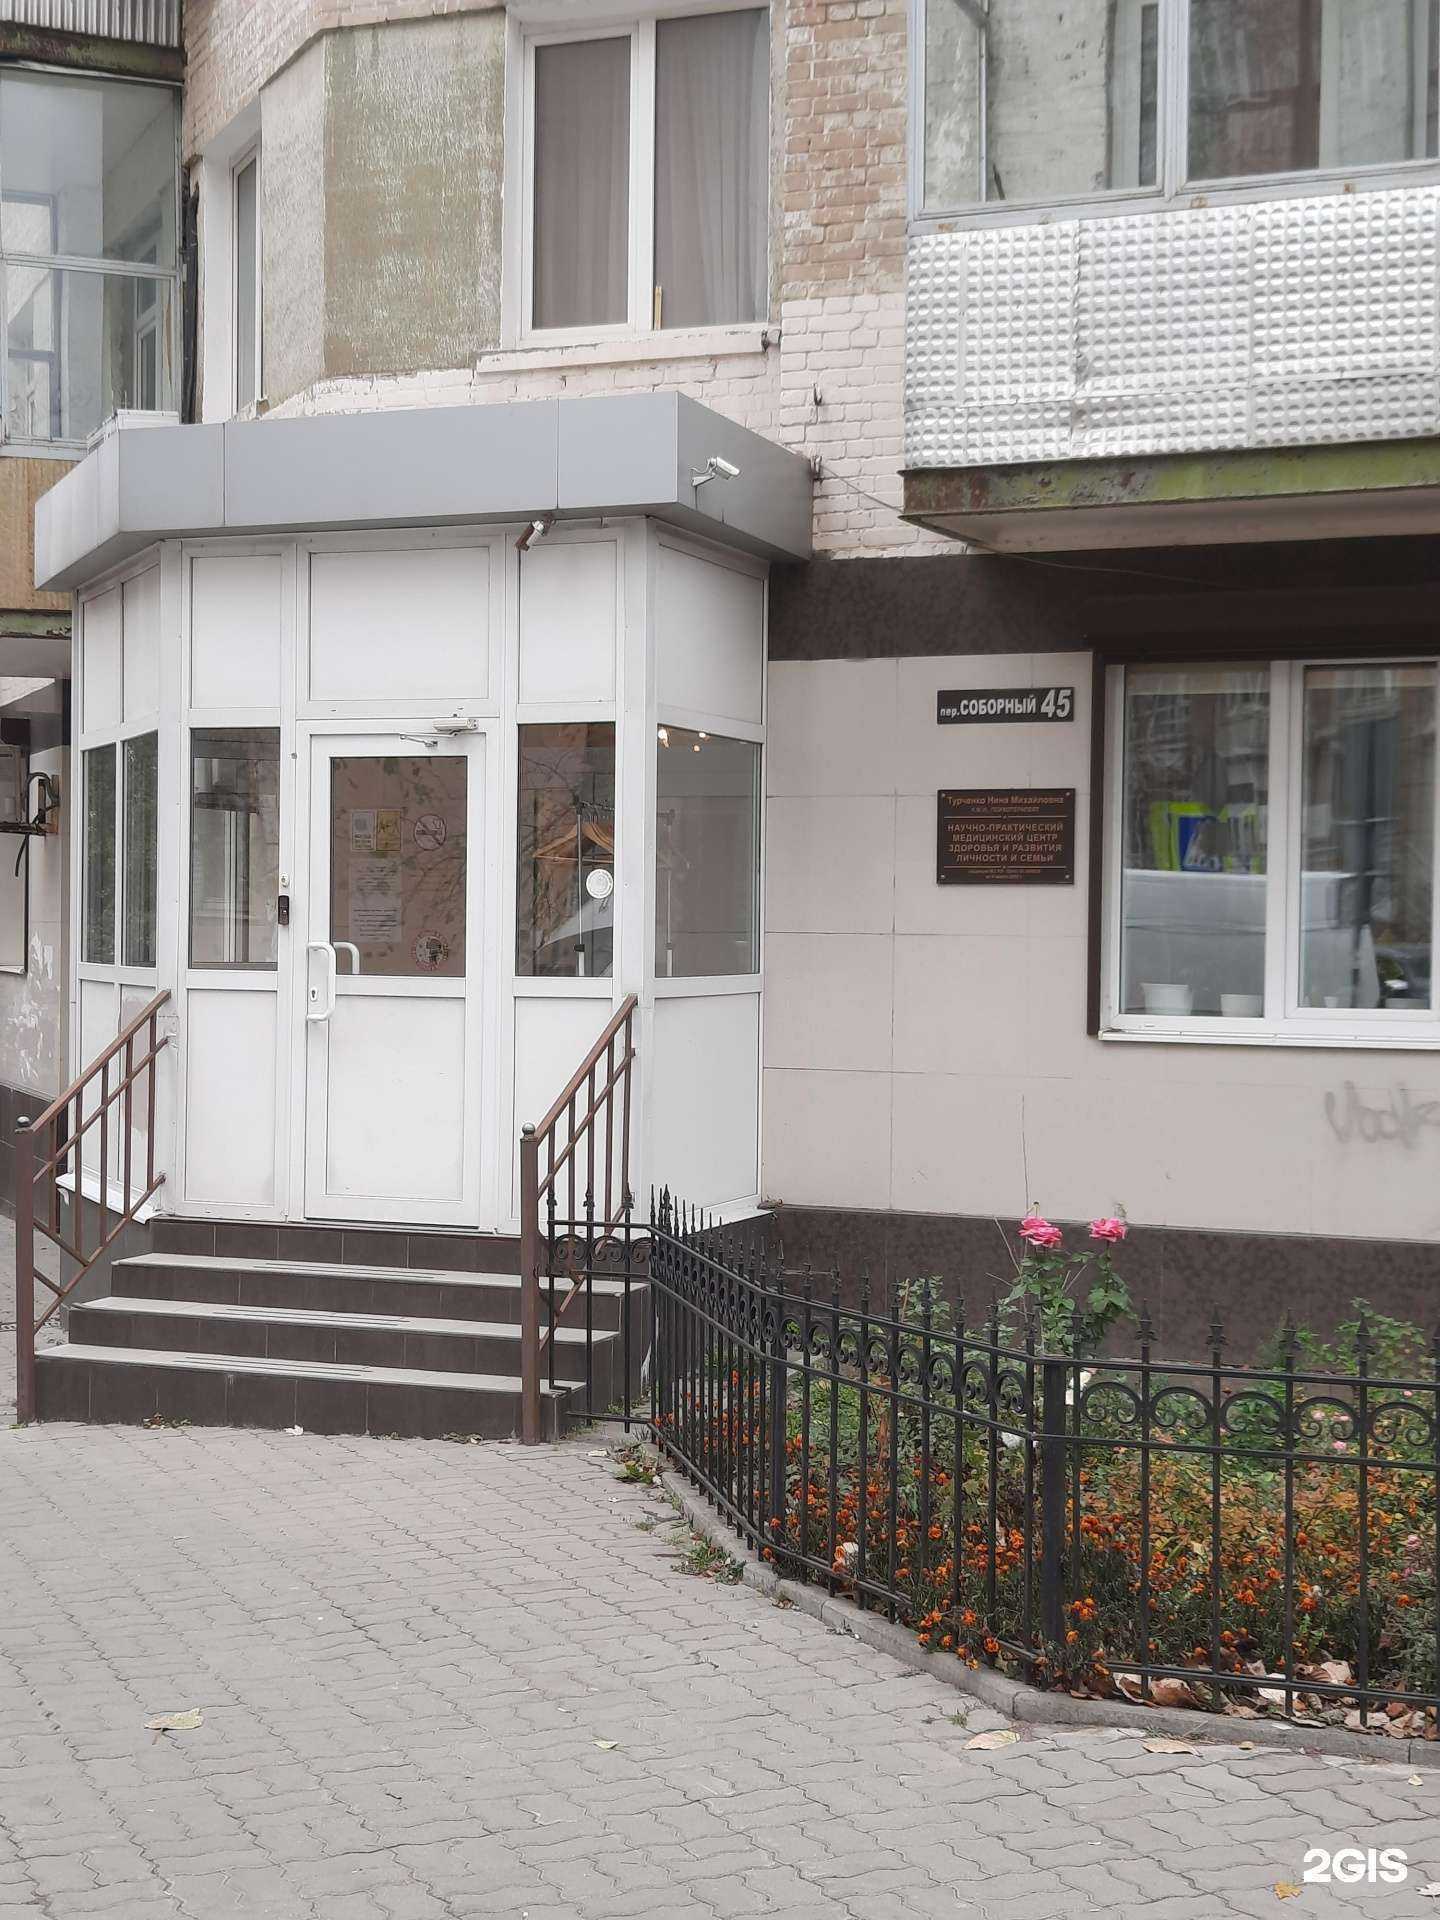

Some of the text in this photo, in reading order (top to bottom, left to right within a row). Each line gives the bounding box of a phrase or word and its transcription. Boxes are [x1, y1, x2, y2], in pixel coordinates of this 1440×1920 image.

[1041, 689, 1071, 718] 45
[947, 822, 1064, 832] НАУЧНО-ПРАКТИЧЕСКИЙ
[952, 832, 1058, 843] МЕДИЦИНСКИЙ ЦЕНТР
[948, 843, 1062, 853] ЗДОРОВЬЯ И РАЗВИТИЯ
[956, 854, 1054, 862] ЛИЧНОСТИ И СЕМЬИ
